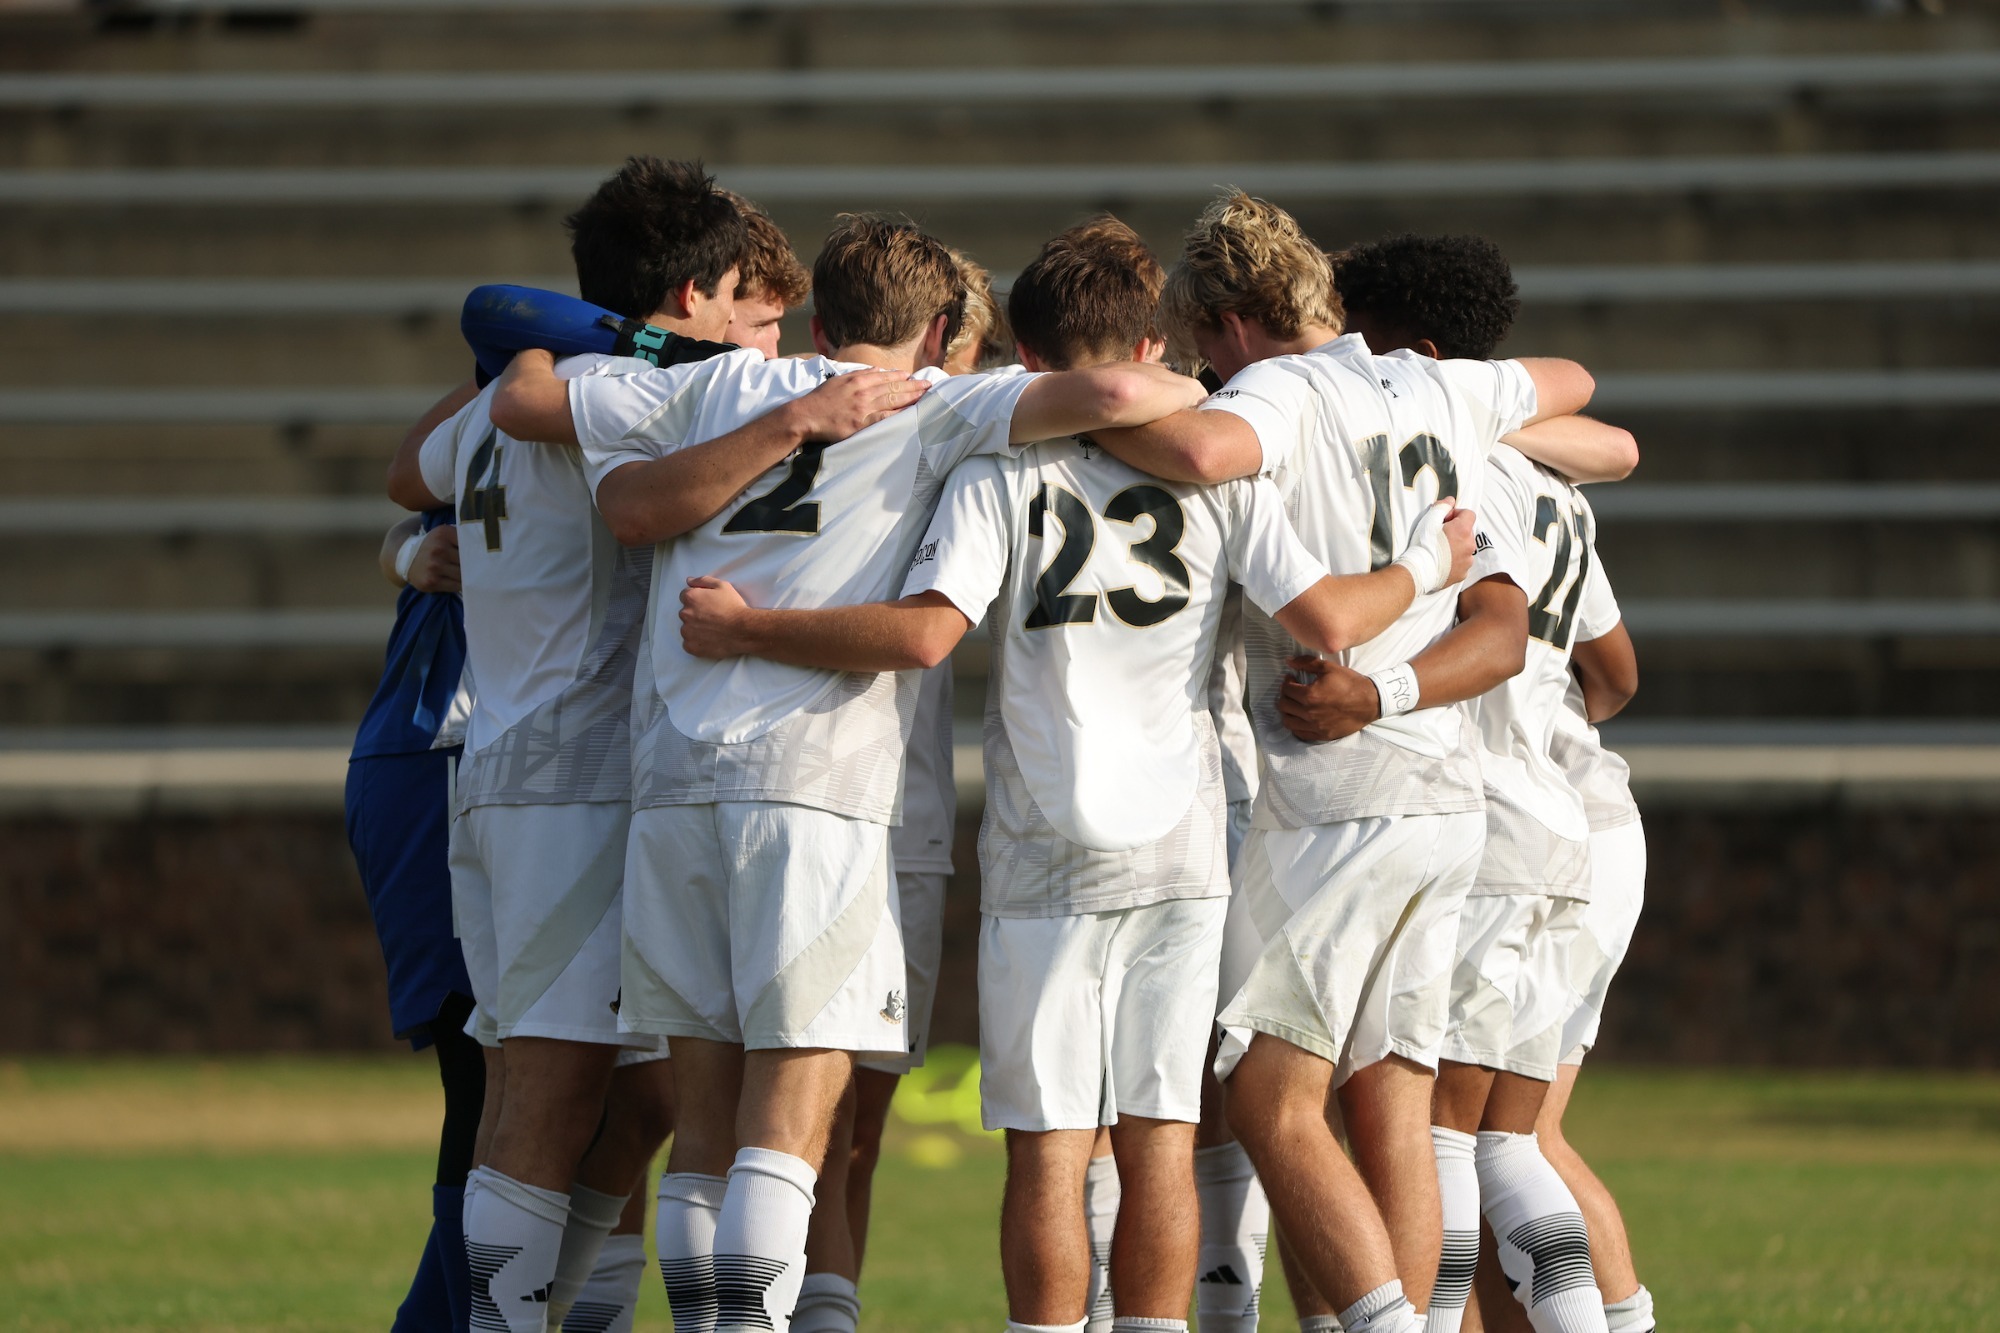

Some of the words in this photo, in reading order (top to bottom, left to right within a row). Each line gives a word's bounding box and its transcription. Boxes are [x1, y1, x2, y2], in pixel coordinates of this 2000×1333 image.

[460, 424, 508, 553] 4
[719, 441, 826, 537] 2
[1023, 480, 1193, 632] 23
